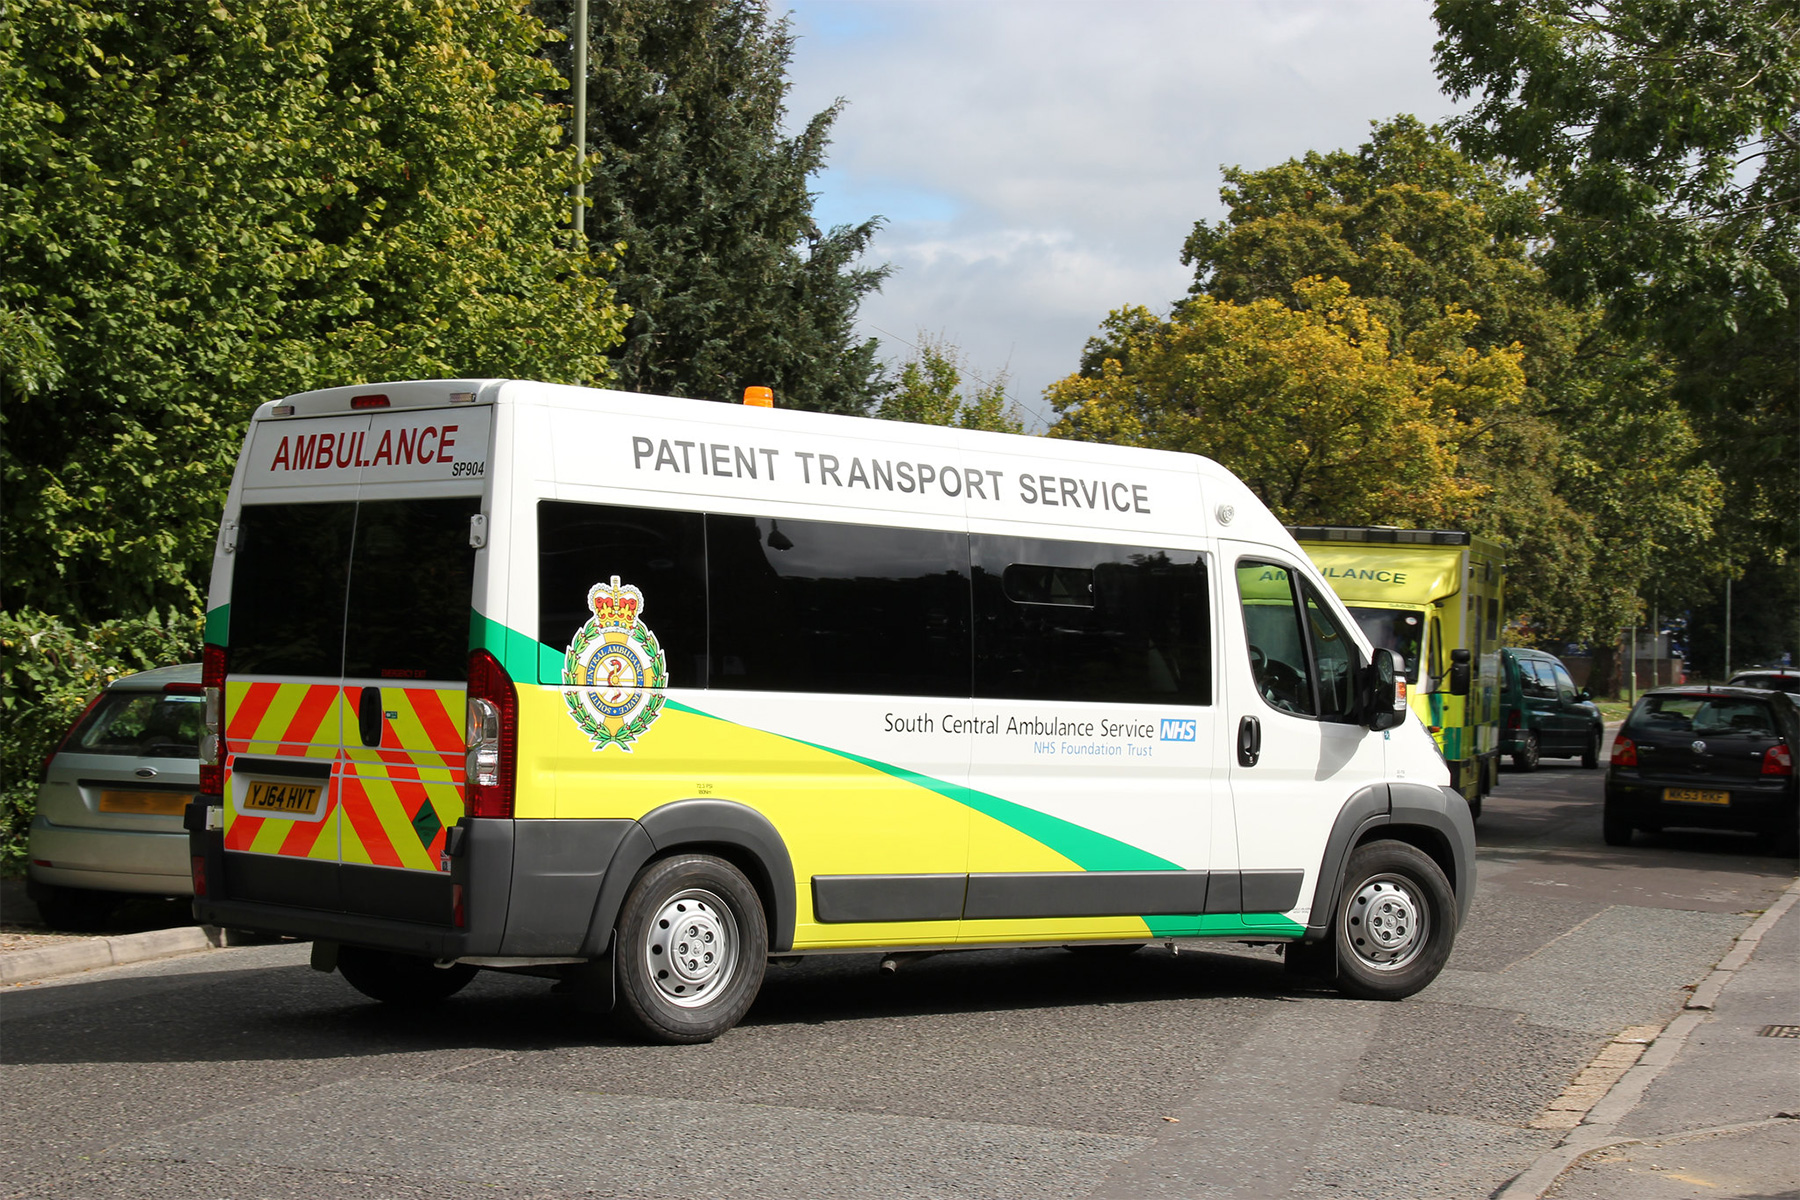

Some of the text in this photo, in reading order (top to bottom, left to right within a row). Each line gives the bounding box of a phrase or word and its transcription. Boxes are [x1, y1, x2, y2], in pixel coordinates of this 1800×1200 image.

[270, 425, 459, 471] AMBULANCE
[452, 461, 485, 476] SP904
[632, 436, 1151, 514] PATIENT TRANSPORT SERVICE
[1259, 567, 1408, 584] AMLANCE
[884, 712, 1196, 741] South Central Ambulance Service NHS
[1034, 741, 1153, 757] NHS Foundation Trust
[251, 784, 316, 810] YJ64 HVT
